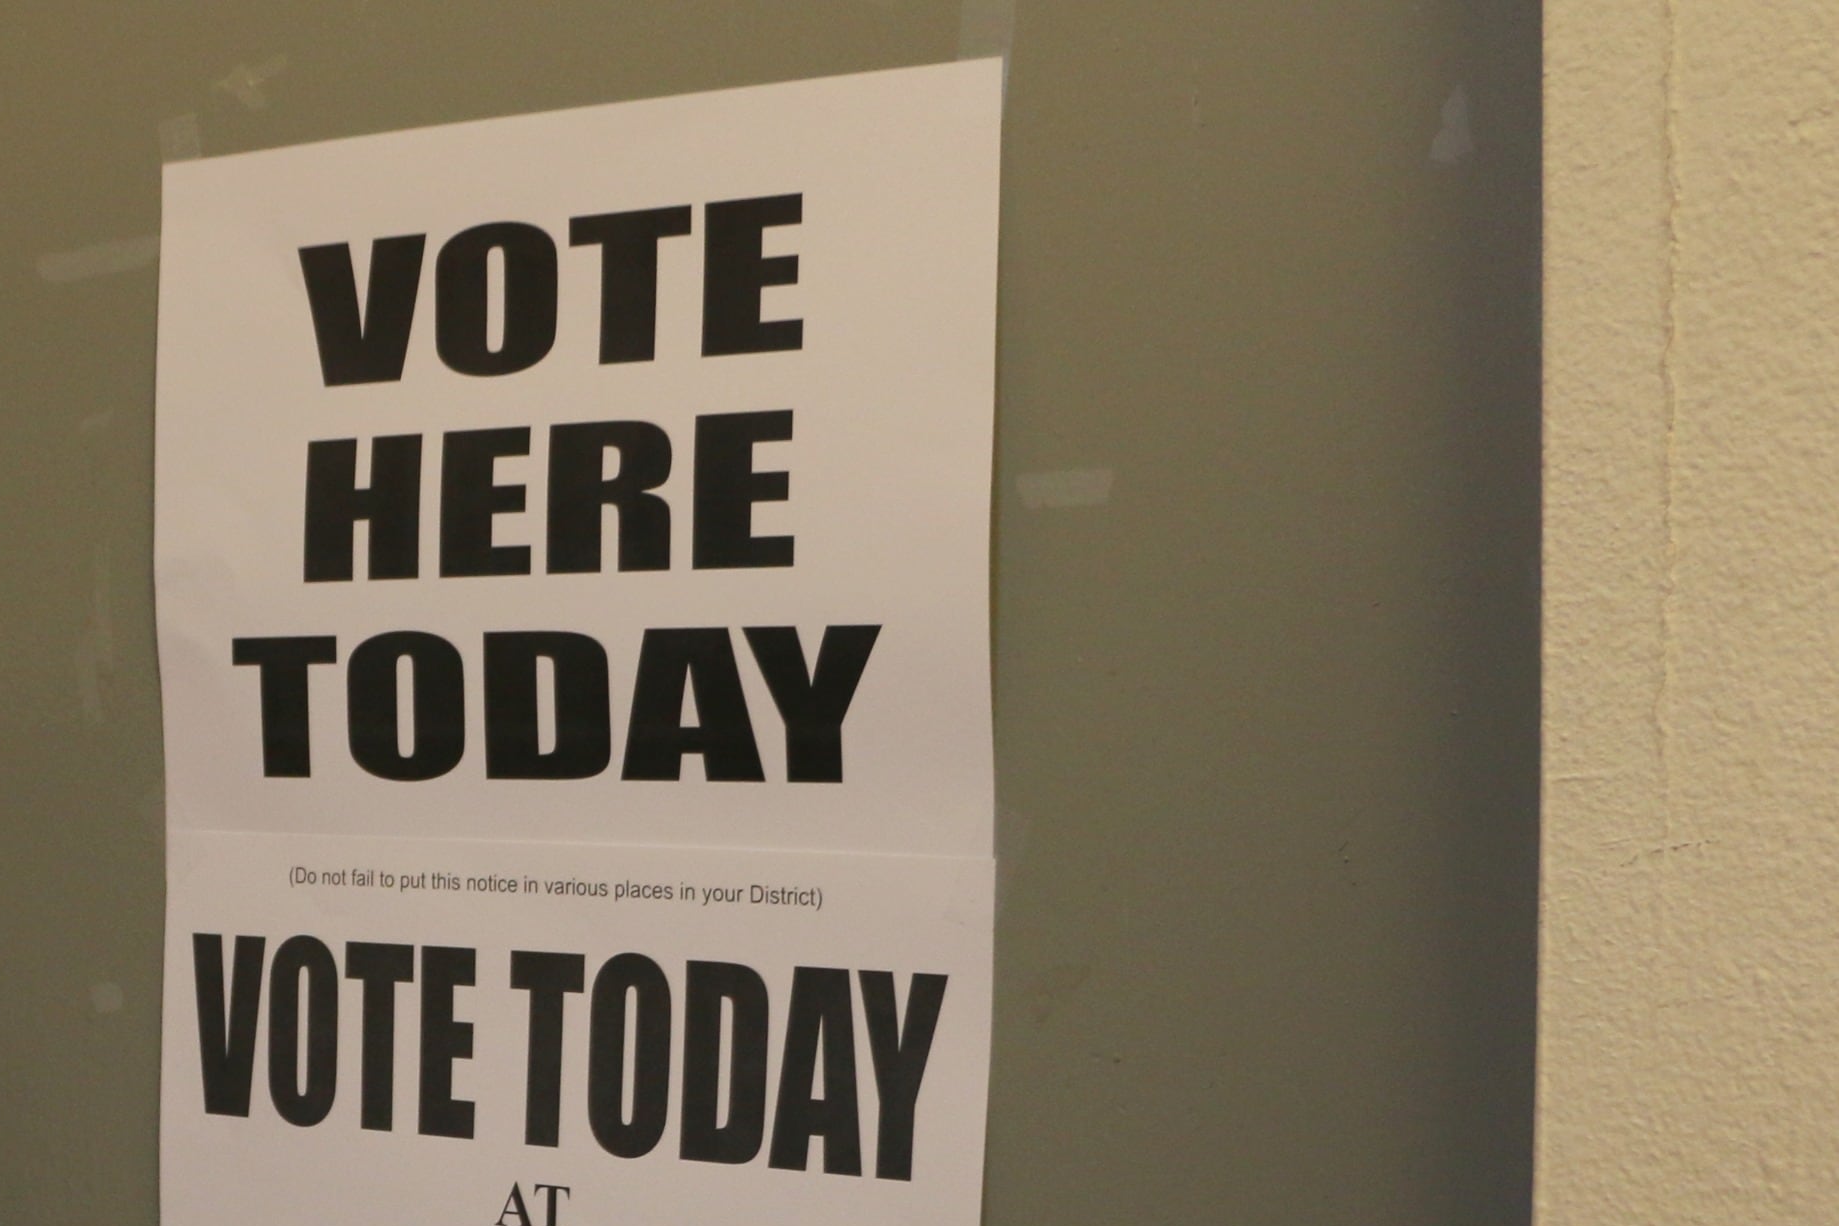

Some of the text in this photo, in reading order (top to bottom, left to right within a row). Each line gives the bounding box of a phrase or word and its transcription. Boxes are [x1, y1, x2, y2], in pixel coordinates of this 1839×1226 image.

[297, 192, 805, 388] VOTE
[302, 408, 796, 584] HERE
[231, 623, 883, 785] TODAY
[289, 867, 824, 911] (Do not fail to put this notice in various places in your District)
[191, 931, 950, 1183] VOTE TODAY
